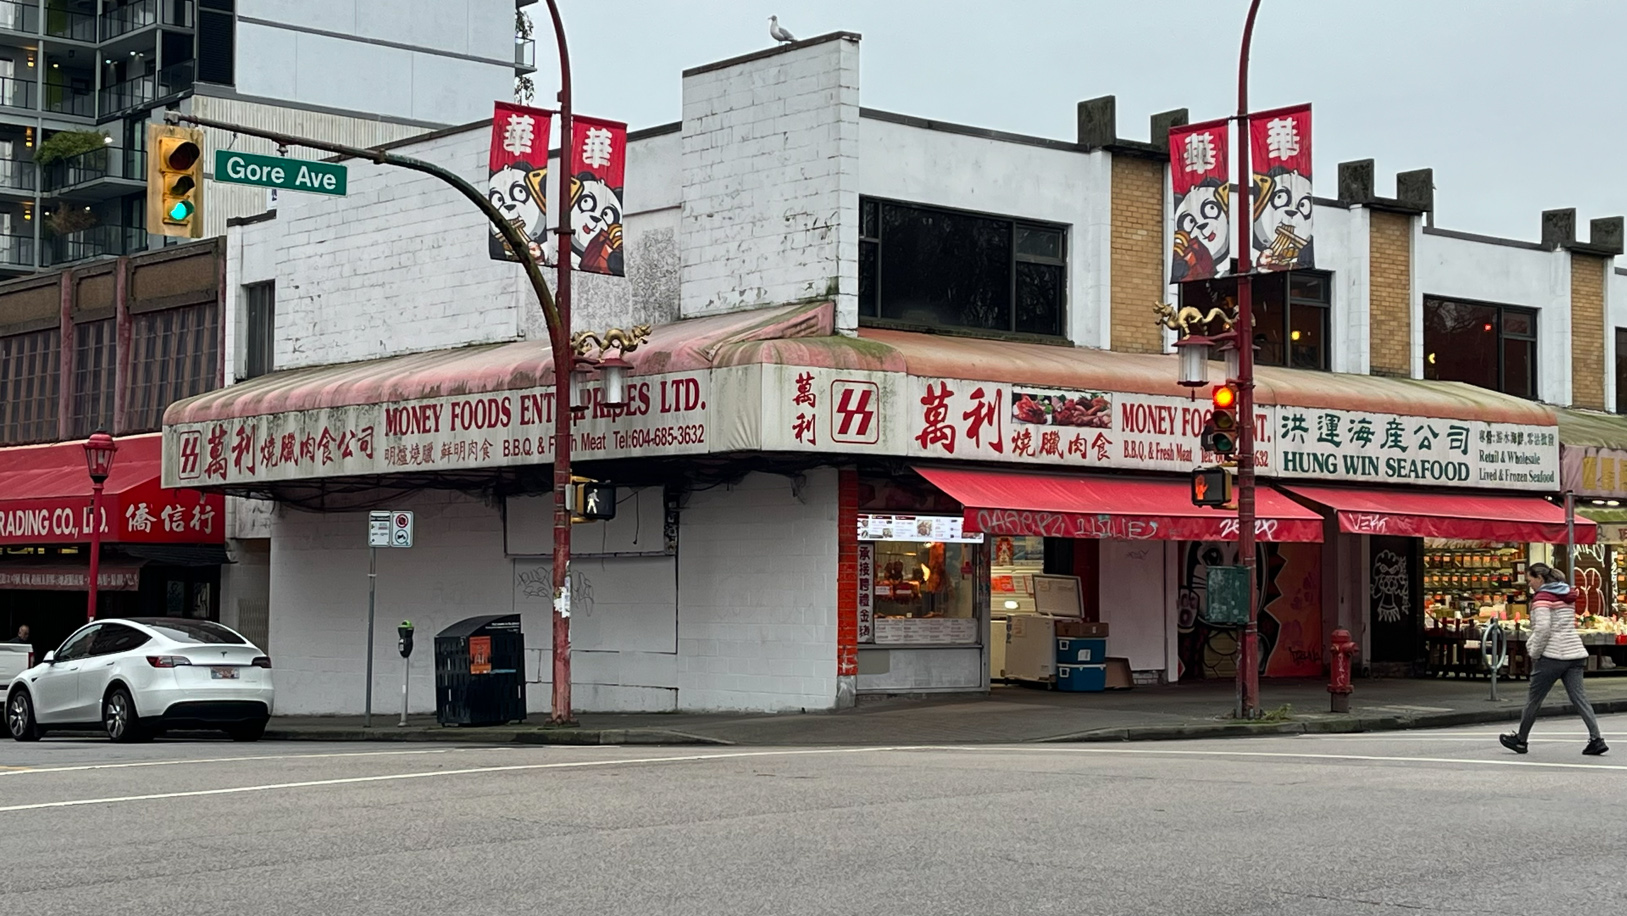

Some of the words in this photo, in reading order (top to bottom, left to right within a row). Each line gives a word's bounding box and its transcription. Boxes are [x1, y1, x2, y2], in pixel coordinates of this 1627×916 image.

[503, 113, 535, 156] 華
[582, 127, 613, 168] 華
[1267, 117, 1300, 161] 華
[1183, 131, 1216, 174] 華
[226, 156, 285, 183] Gore
[295, 165, 337, 190] Ave
[384, 403, 443, 437] MONEY
[450, 396, 511, 432] FOODS
[660, 377, 706, 414] LTD.
[792, 371, 817, 446] 萬利
[915, 380, 1004, 455] 萬利
[1121, 402, 1178, 436] MONEY
[440, 438, 494, 464] 鮮明肉食
[503, 437, 533, 457] B.B.Q.
[537, 436, 545, 454] &
[581, 432, 606, 451] Meat
[1123, 439, 1147, 462] B.B.Q.
[1148, 441, 1155, 460] &
[1155, 442, 1175, 461] Fresh
[1176, 443, 1192, 463] Meat
[1479, 449, 1499, 463] Retail
[1500, 450, 1506, 463] &
[1506, 450, 1541, 465] Wholesale
[1282, 450, 1338, 475] HUNG
[1342, 455, 1379, 476] WIN
[1385, 457, 1470, 482] SEAFOOD
[1479, 467, 1497, 481] Lived
[1498, 468, 1504, 482] &
[1505, 468, 1528, 483] Frozen
[1528, 469, 1555, 483] Seafood
[53, 507, 79, 539] CO.,
[125, 503, 215, 535] 僑信行
